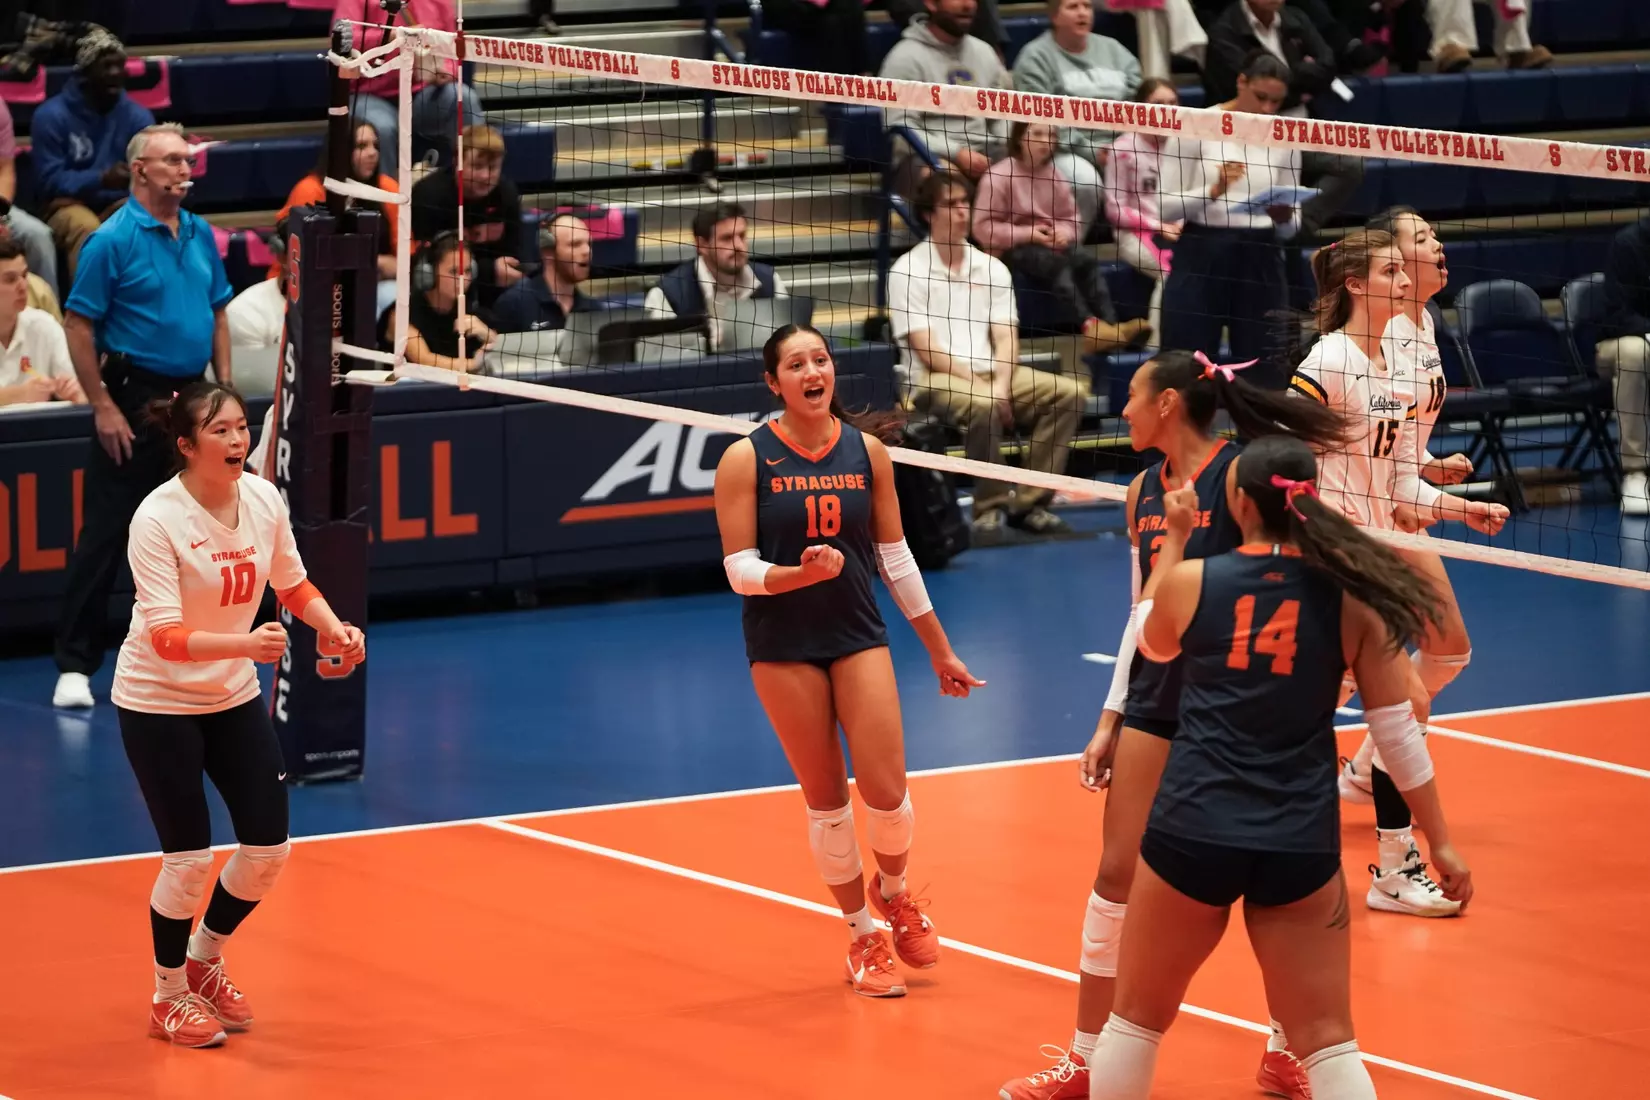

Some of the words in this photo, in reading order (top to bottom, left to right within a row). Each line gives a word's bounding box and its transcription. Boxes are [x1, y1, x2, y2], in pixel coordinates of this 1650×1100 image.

[474, 38, 543, 64] SYRACUSE
[547, 46, 638, 75] VOLLEYBALL
[670, 59, 680, 80] S
[712, 64, 790, 91] SYRACUSE
[795, 72, 897, 102] VOLLEYBALL
[931, 85, 940, 107] S
[977, 90, 1064, 119] SYRACUSE
[1070, 99, 1181, 131] VOLLEYBALL
[1221, 113, 1233, 135] S
[1273, 119, 1370, 149] SYRACUSE
[1376, 127, 1504, 162] VOLLEYBALL
[1549, 143, 1561, 167] S
[1606, 148, 1650, 174] SYR
[1370, 394, 1401, 413] California
[1374, 420, 1399, 457] 15
[771, 474, 865, 493] SYRACUSE
[805, 494, 841, 538] 18
[211, 545, 257, 562] SYRACUSE
[220, 562, 256, 607] 10
[1227, 594, 1301, 676] 14
